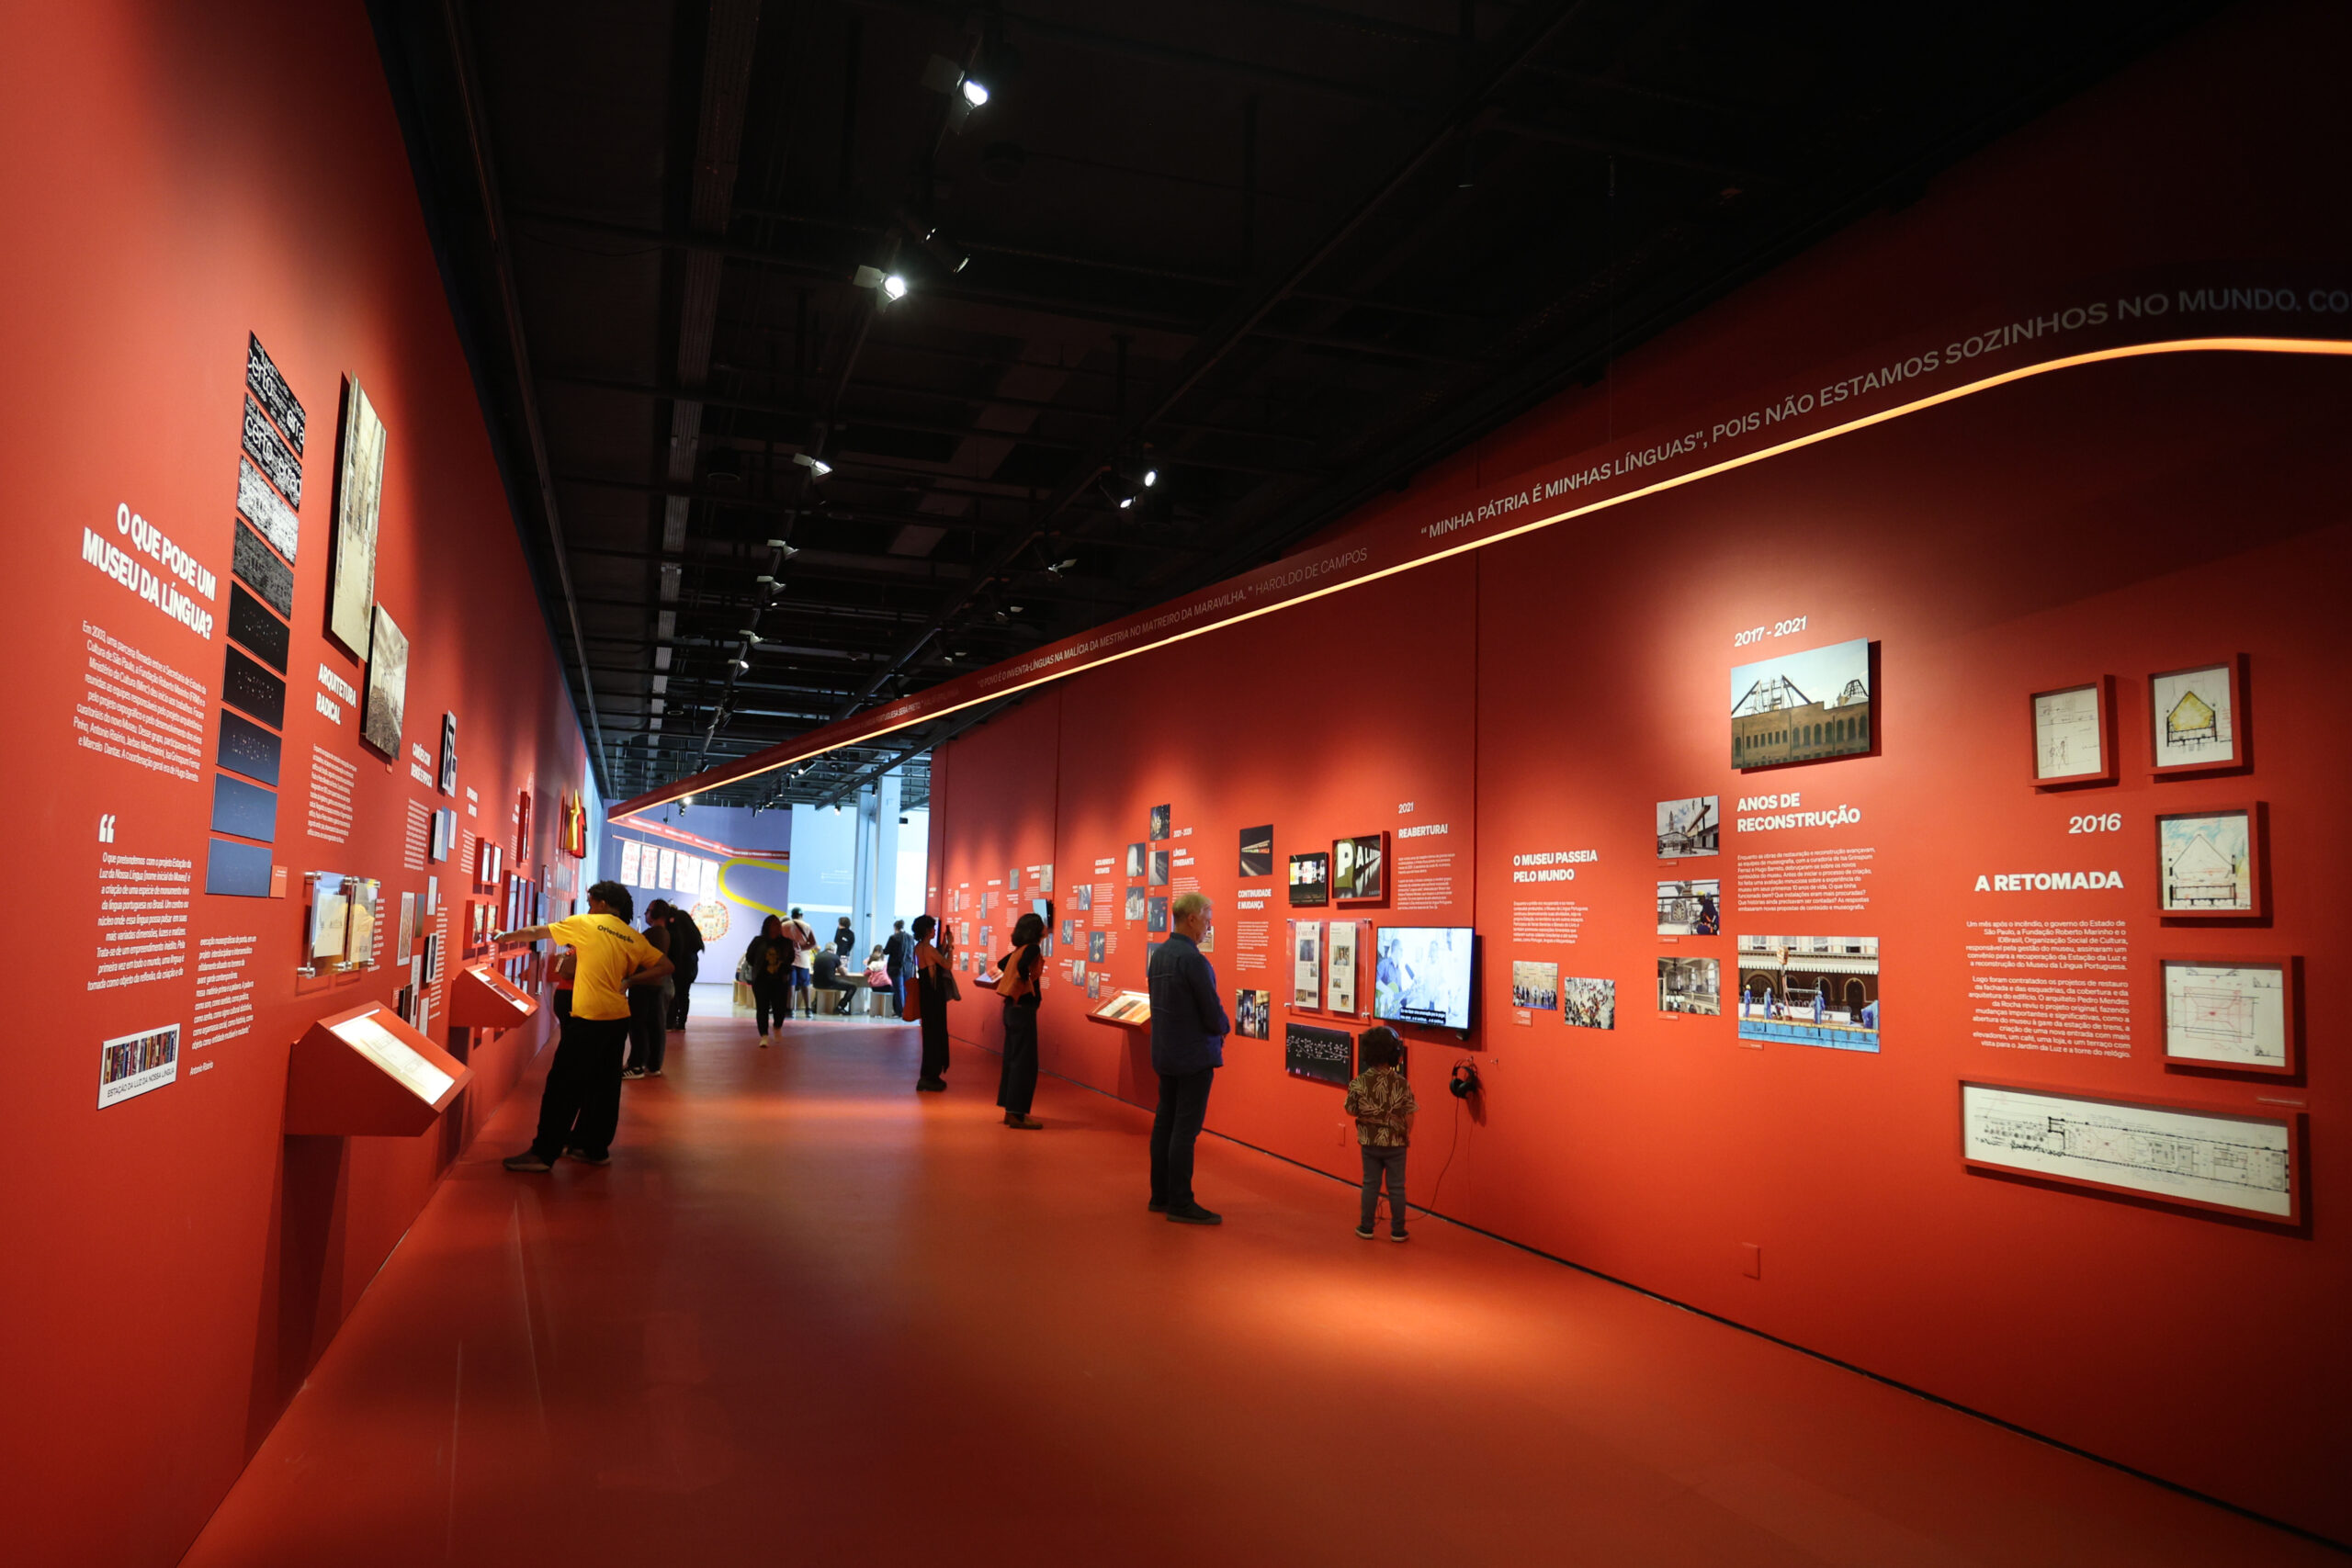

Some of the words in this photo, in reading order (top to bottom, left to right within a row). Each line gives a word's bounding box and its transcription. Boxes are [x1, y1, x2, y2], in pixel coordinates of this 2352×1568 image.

[1477, 492, 1529, 522] PÁTRIA
[1532, 484, 1542, 502] É
[1545, 463, 1611, 499] MINHAS
[1713, 412, 1760, 443] POIS
[1766, 395, 1814, 425] NÃO
[1820, 351, 1939, 407] ESTAMOS
[1945, 302, 2109, 365] SOZINHOS
[2118, 293, 2168, 320] NO
[2179, 288, 2301, 312] MUNDO.
[2308, 289, 2352, 313] CO
[117, 502, 130, 535] O
[131, 514, 162, 561] QUE
[162, 536, 198, 587] PODE
[198, 565, 216, 601] UM
[83, 526, 140, 592] MUSEU
[140, 568, 159, 607] DA
[161, 581, 213, 639] LÍNGUA?
[1055, 651, 1063, 661] NA
[1064, 643, 1089, 660] MALÍCIA
[1090, 639, 1099, 650] DA
[1100, 630, 1128, 647] MESTRIA
[1130, 626, 1140, 637] NO
[1142, 612, 1181, 632] MATREIRO
[1182, 607, 1193, 620] DA
[1256, 570, 1303, 595] HAROLDO
[1306, 563, 1318, 579] DE
[1321, 547, 1367, 574] CAMPOS
[1735, 626, 1765, 647] 2017
[1774, 615, 1806, 637] 2021
[318, 663, 356, 708] ARQUITETURA
[316, 692, 341, 725] RADICAL
[1398, 802, 1414, 814] 2021
[1737, 795, 1777, 812] ANOS
[1781, 793, 1800, 807] DE
[1737, 805, 1860, 832] RECONSTRUÇÃO
[2069, 813, 2121, 834] 2016
[1398, 824, 1448, 839] REABERTURA!
[1513, 855, 1521, 866] O
[1522, 852, 1554, 865] MUSEU
[1555, 850, 1598, 863] PASSEIA
[1513, 871, 1536, 883] PELO
[1538, 869, 1574, 882] MUNDO
[1974, 875, 1990, 891] A
[1995, 871, 2124, 891] RETOMADA
[598, 925, 634, 943] Orientação
[2068, 953, 2096, 962] Estação
[107, 1085, 127, 1098] ESTAÇÃO
[128, 1082, 133, 1090] DA
[149, 1071, 162, 1082] NOSSA
